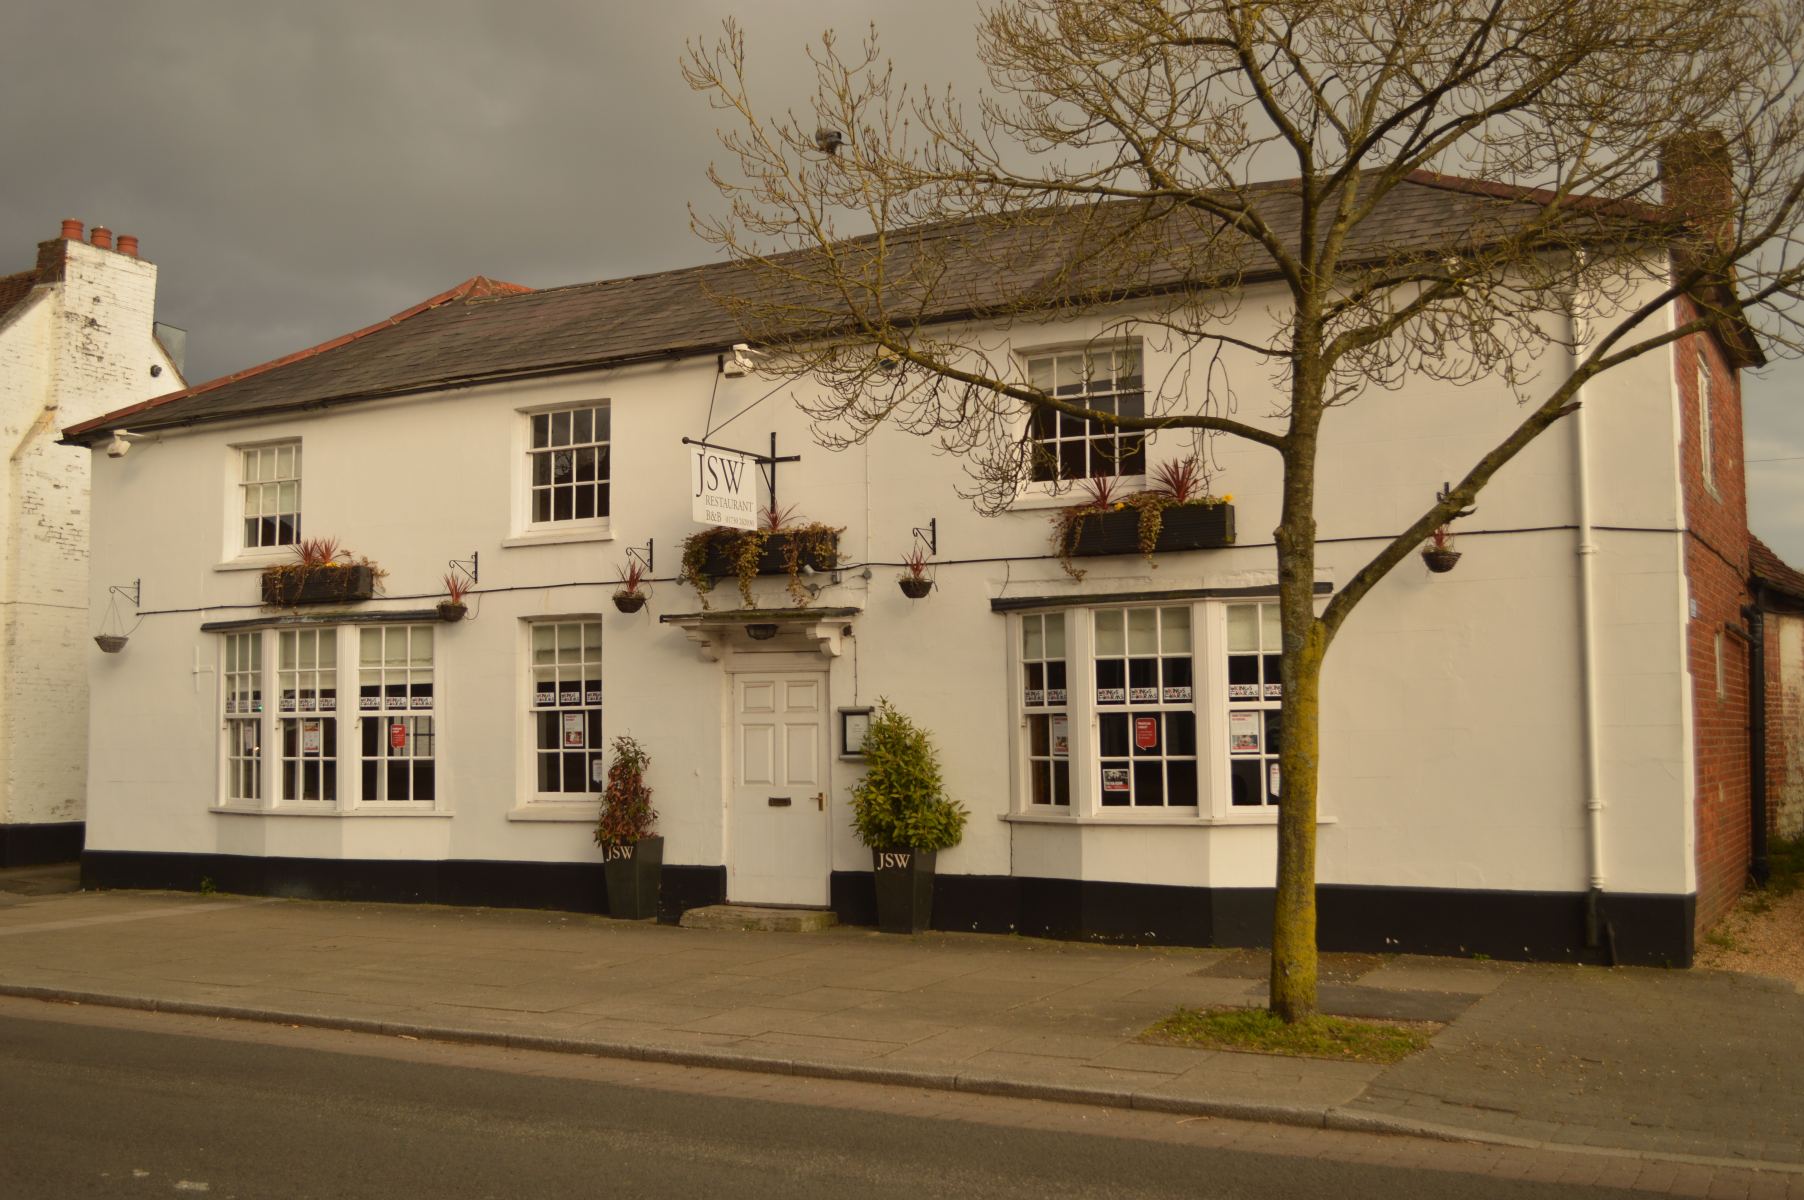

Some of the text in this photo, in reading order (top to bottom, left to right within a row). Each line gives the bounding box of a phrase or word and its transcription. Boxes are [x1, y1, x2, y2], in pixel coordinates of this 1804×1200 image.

[696, 453, 746, 497] JSW
[705, 495, 754, 512] RESTAURANT
[706, 510, 721, 522] B&B
[606, 845, 634, 862] JSW
[877, 852, 911, 871] JSW
